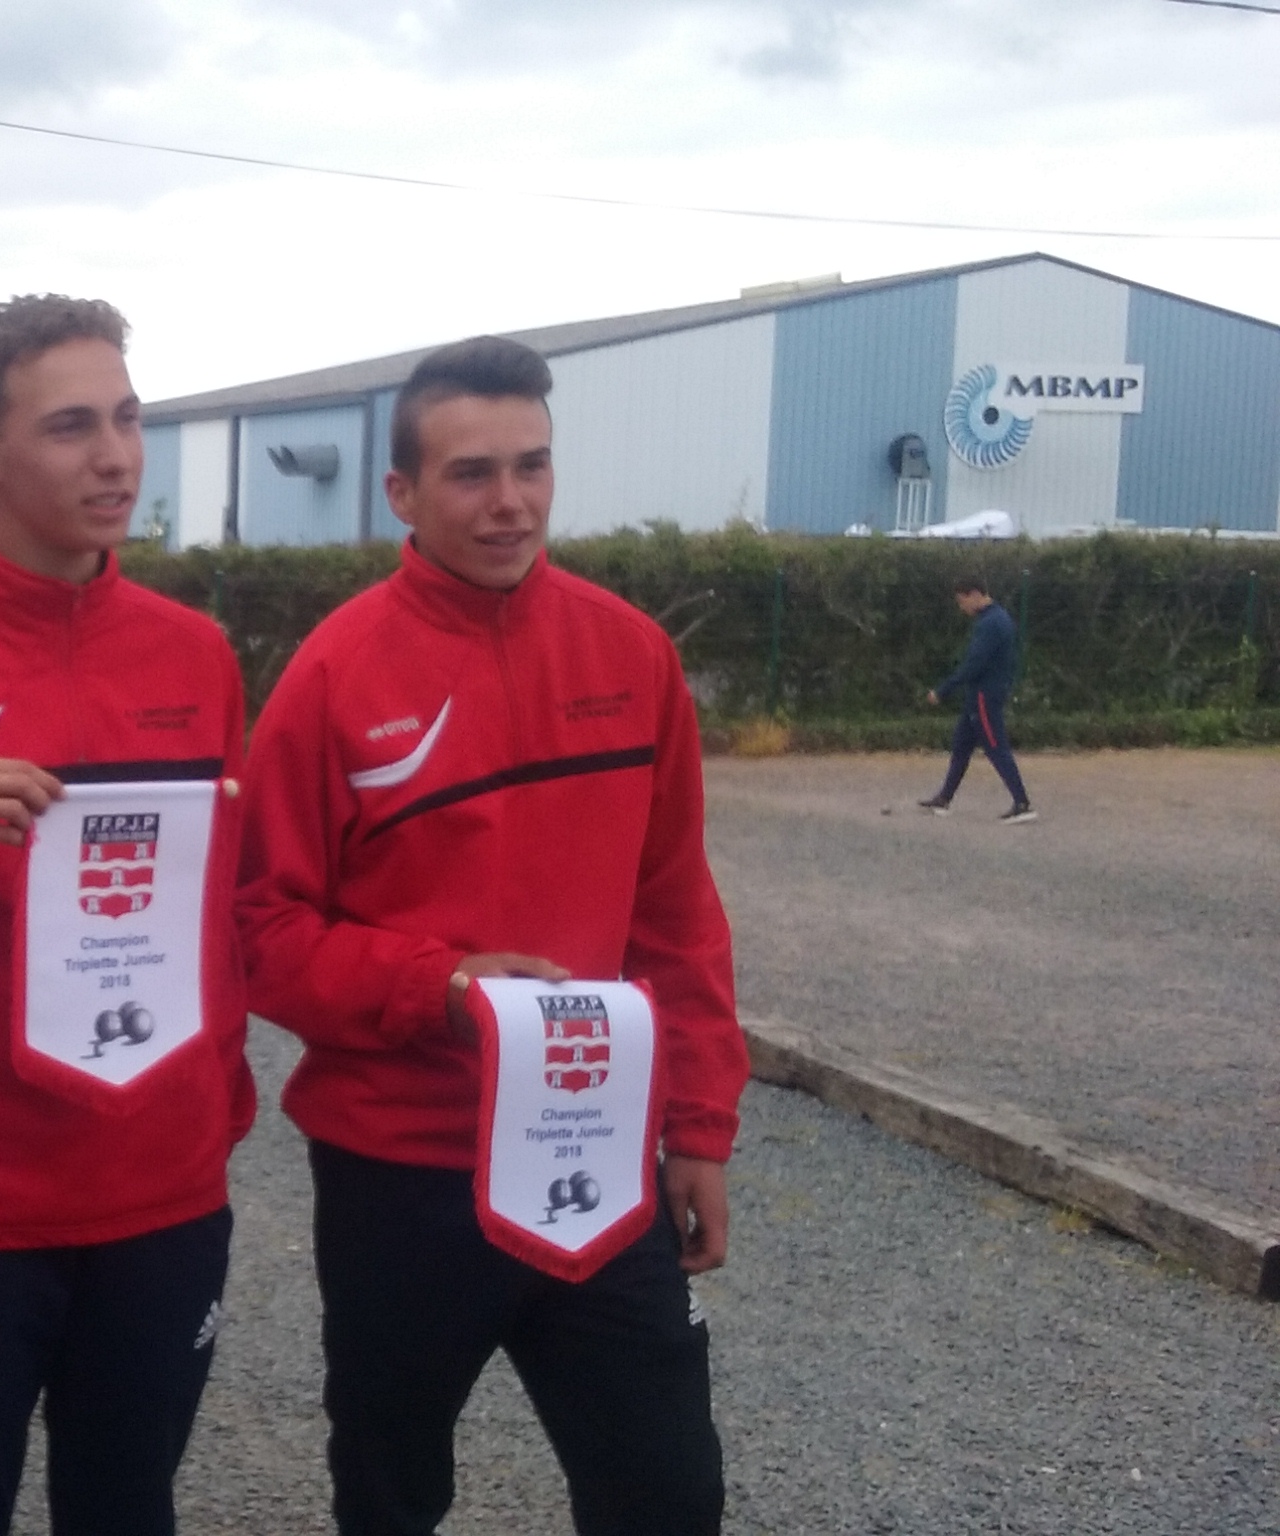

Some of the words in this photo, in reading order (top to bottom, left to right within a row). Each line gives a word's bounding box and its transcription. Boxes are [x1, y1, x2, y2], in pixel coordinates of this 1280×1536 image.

[1004, 373, 1139, 399] MBMP
[80, 935, 149, 950] Champion
[64, 957, 119, 973] Triplette
[123, 952, 165, 967] Junior
[541, 1107, 602, 1123] Champion
[525, 1127, 573, 1143] Triplette
[576, 1125, 615, 1139] Junior
